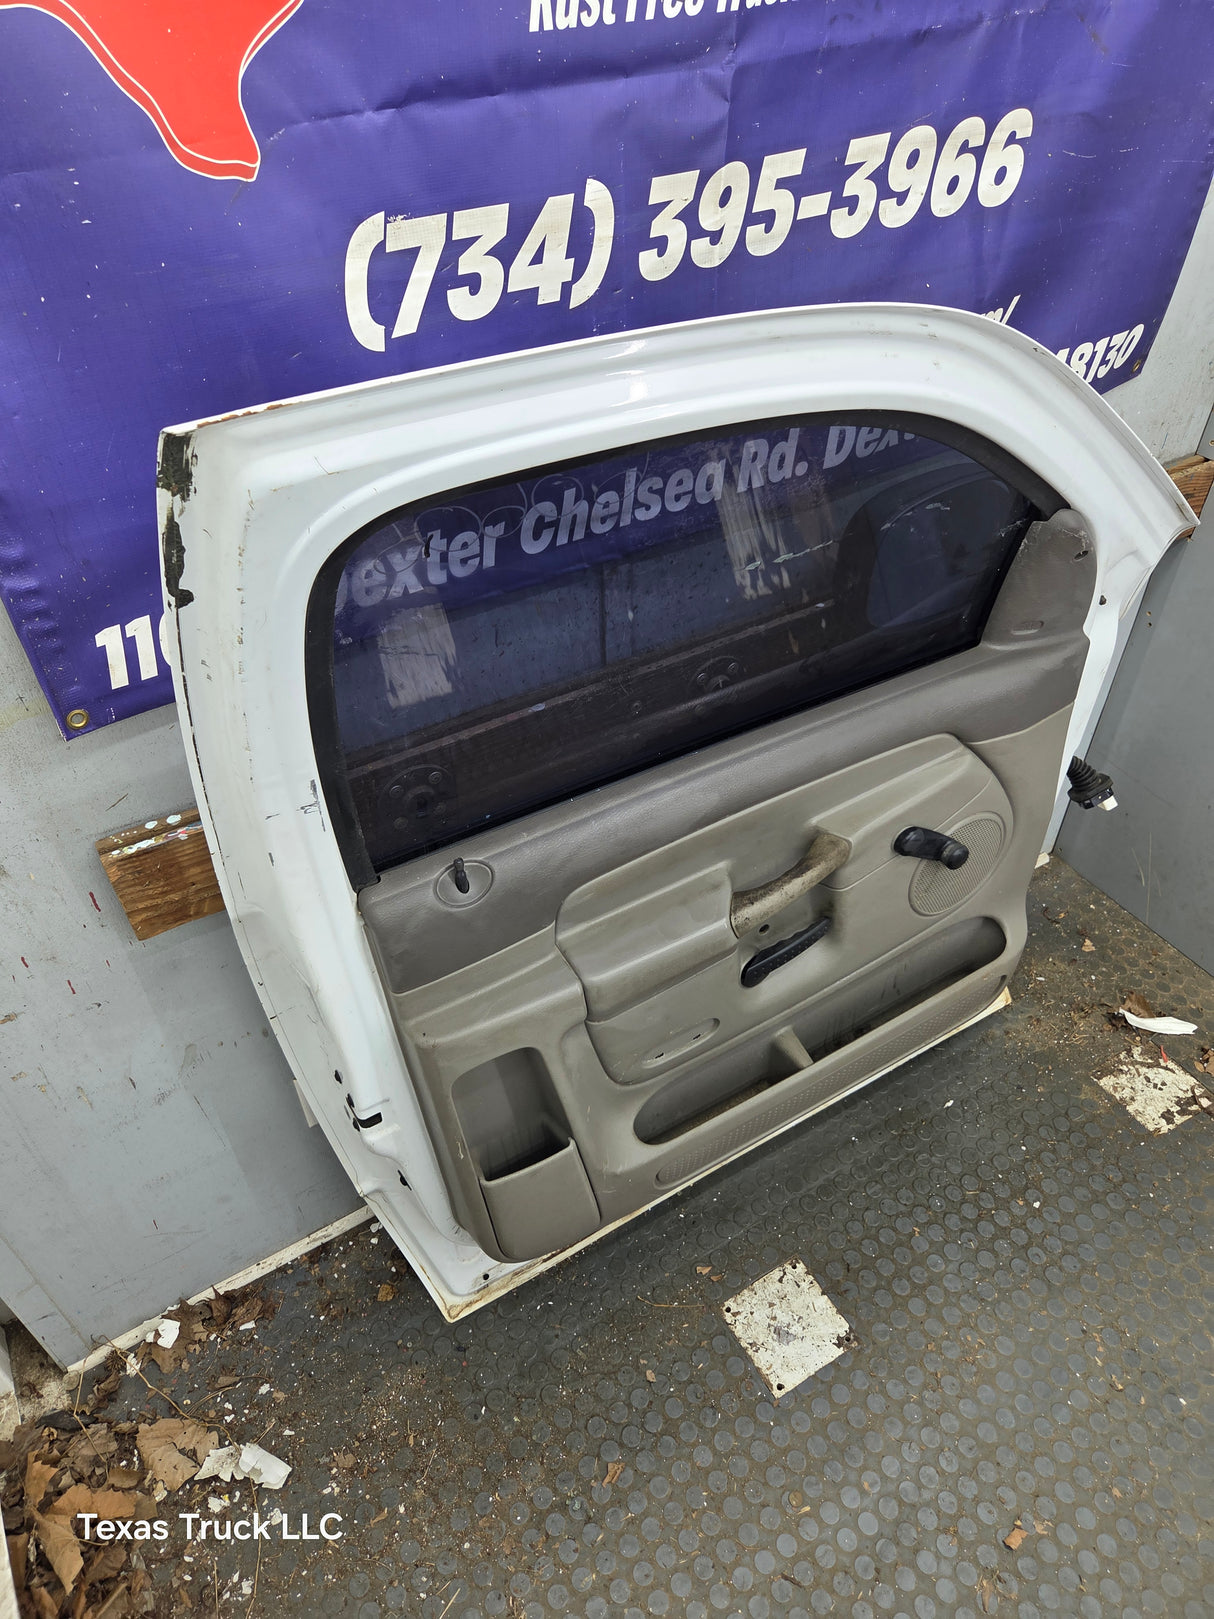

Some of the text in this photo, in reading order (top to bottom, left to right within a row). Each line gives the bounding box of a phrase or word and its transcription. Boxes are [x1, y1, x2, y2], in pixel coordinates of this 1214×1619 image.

[345, 108, 1034, 352] (734) 395-3966
[520, 458, 726, 555] Chelsea
[737, 428, 809, 494] Rd.
[823, 425, 916, 470] Dex
